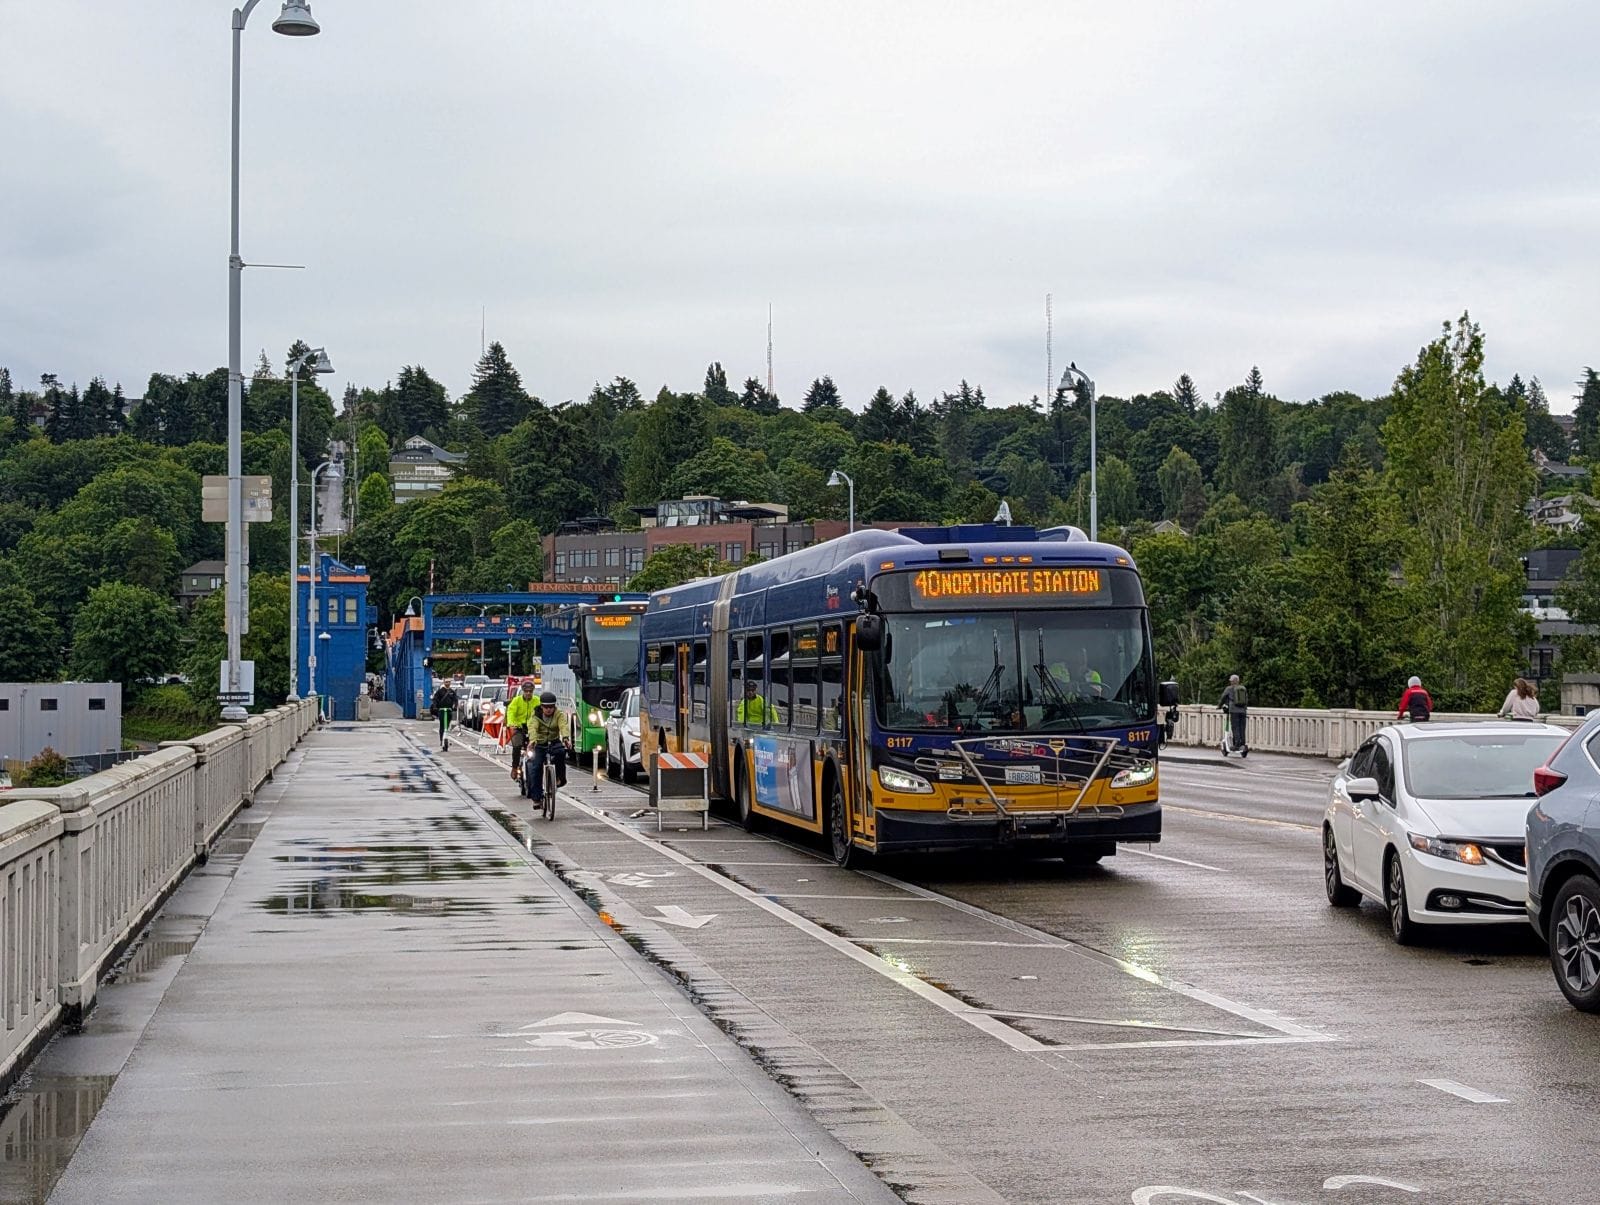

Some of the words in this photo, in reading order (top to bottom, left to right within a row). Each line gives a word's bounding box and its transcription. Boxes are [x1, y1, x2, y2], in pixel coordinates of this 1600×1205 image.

[531, 583, 577, 592] FREMONT
[582, 583, 616, 592] BRIDGE
[915, 570, 940, 597] 40
[942, 571, 1030, 595] NORTHGATE
[1033, 570, 1100, 593] STATION
[887, 736, 913, 748] 8117
[1128, 731, 1150, 742] 8117
